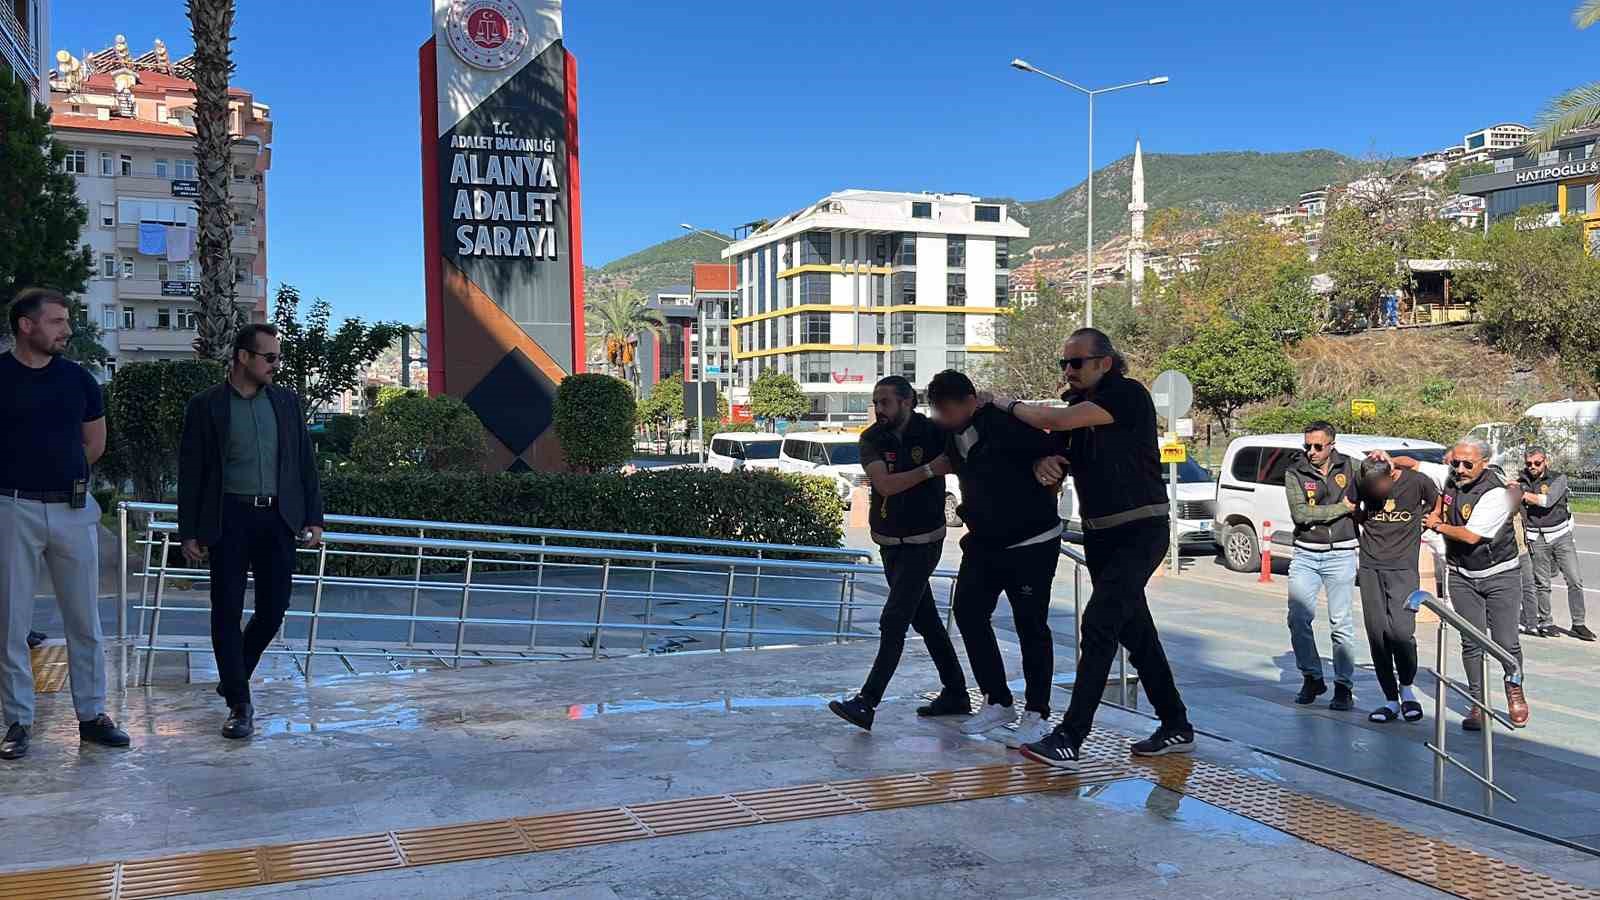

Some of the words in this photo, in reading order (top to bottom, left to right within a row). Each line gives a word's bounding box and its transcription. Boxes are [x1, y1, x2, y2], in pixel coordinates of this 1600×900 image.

[492, 121, 512, 135] T.C.
[450, 135, 493, 149] ADALET
[496, 137, 555, 153] BAKANLIĞI
[450, 154, 558, 187] ALANYA
[453, 189, 557, 222] ADALET
[456, 225, 556, 257] SARAYI
[1369, 511, 1411, 522] ENZO
